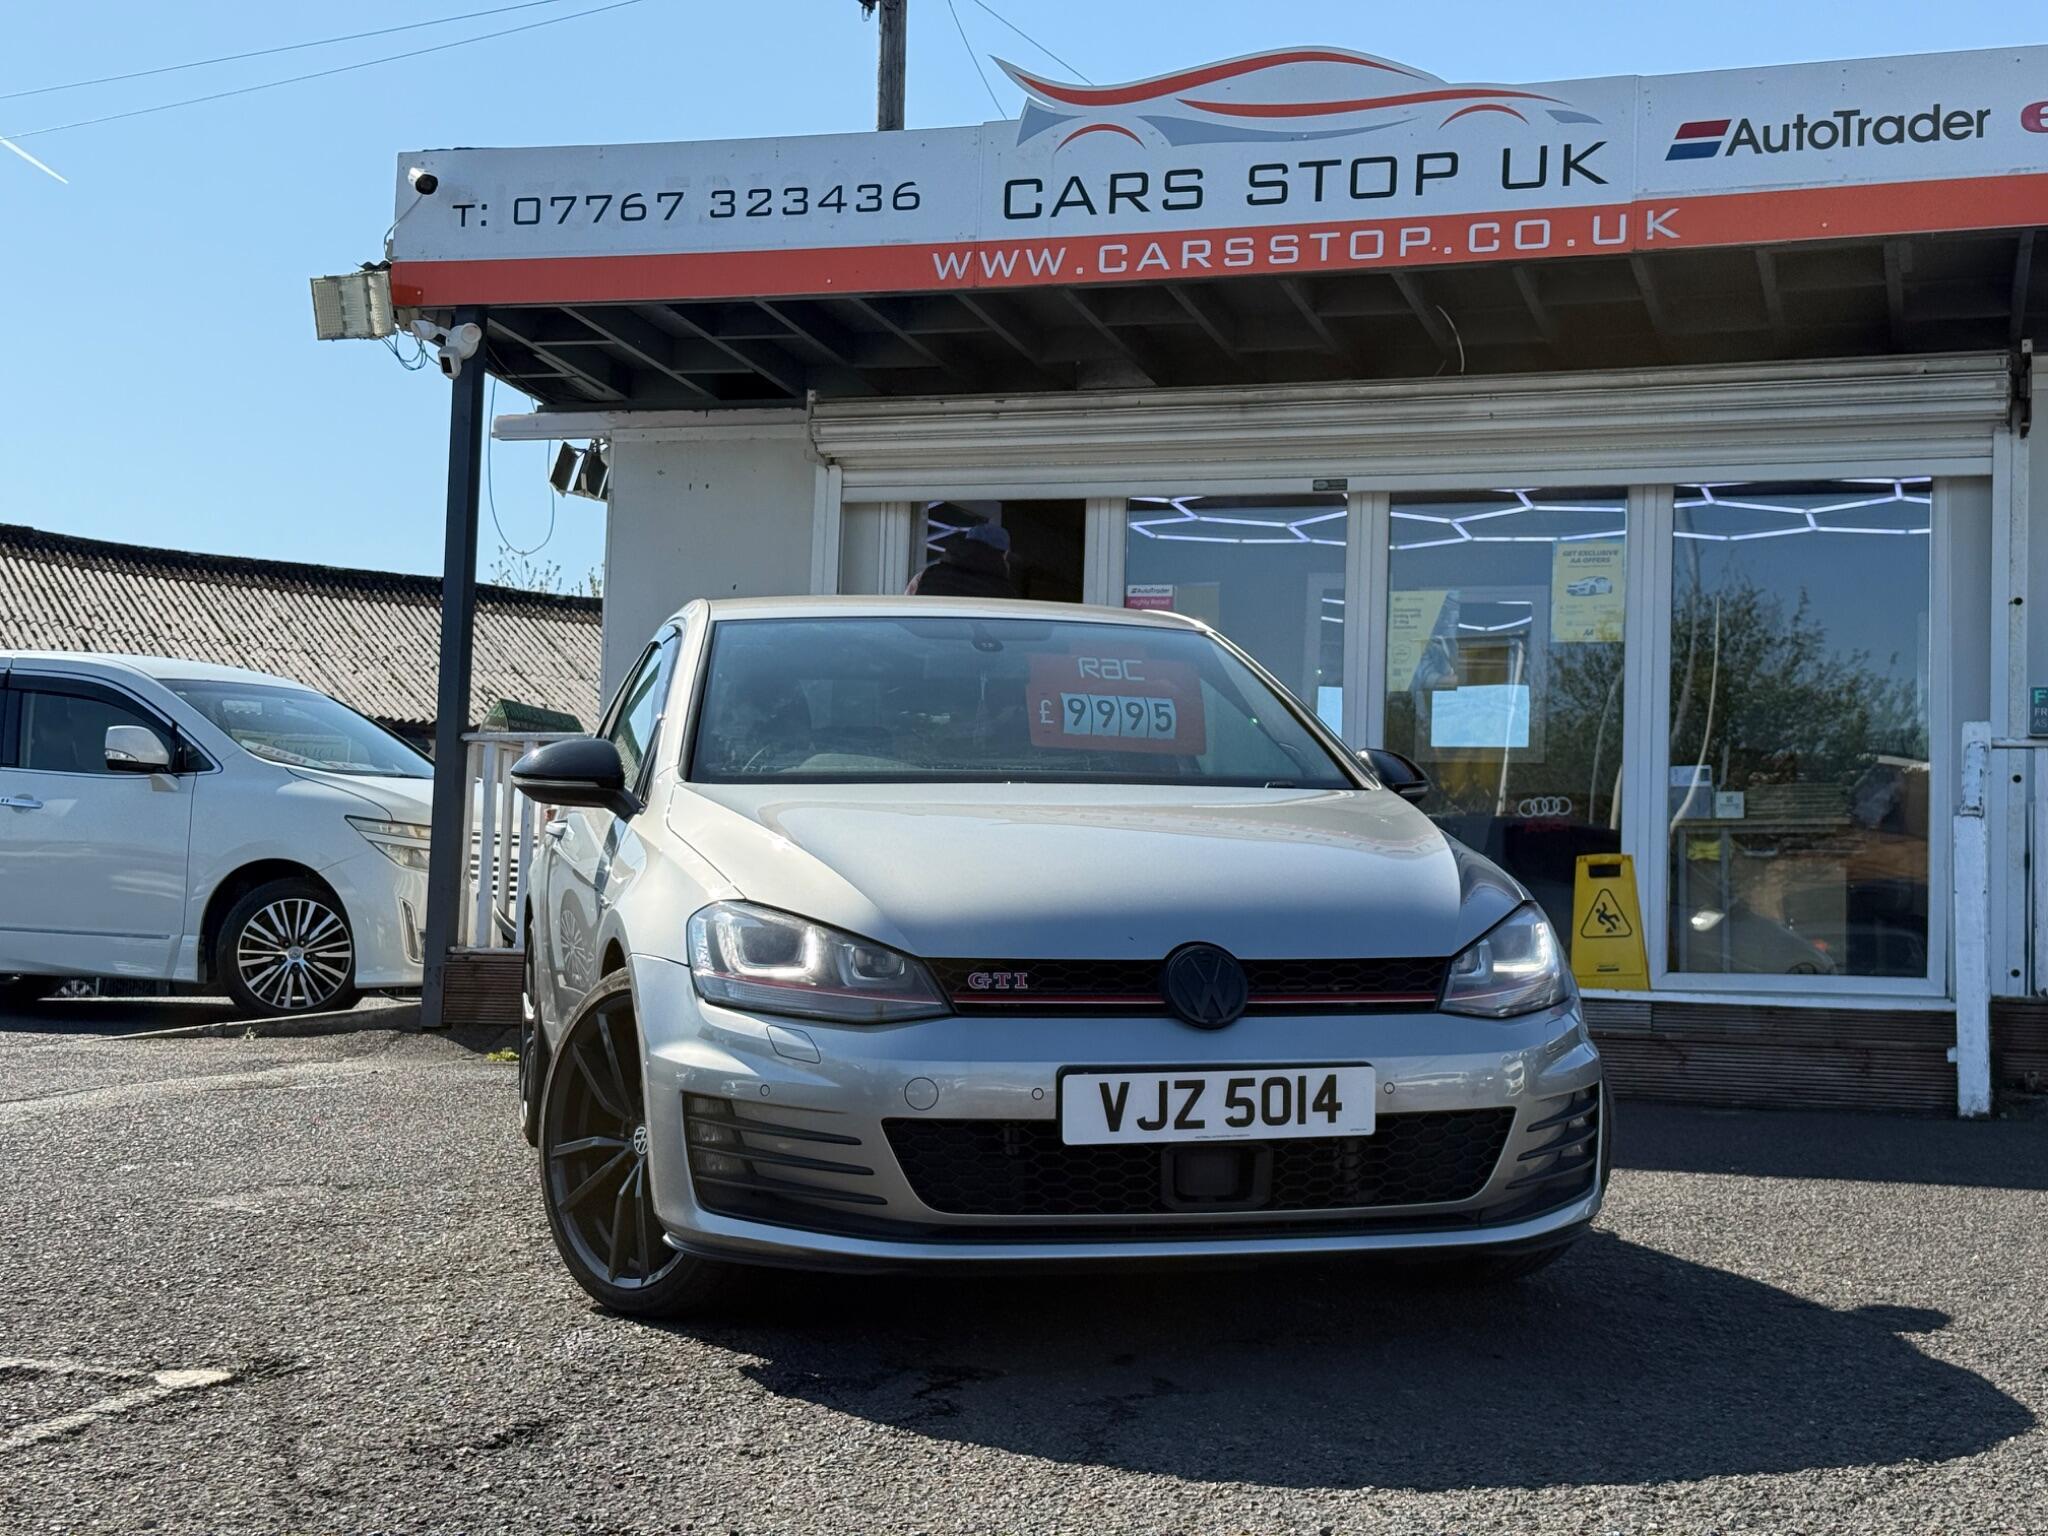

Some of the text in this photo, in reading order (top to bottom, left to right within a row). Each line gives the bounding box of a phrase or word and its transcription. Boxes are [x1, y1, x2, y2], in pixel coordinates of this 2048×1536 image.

[1725, 103, 1991, 157] AutoTrader
[452, 181, 921, 228] T: 07767 323436
[1003, 140, 1610, 220] CARS STOP UK
[932, 207, 1681, 281] WWW.CARSSTOP.CO.UK
[966, 971, 1029, 990] GTI
[1098, 1073, 1343, 1133] VJZ 5014
